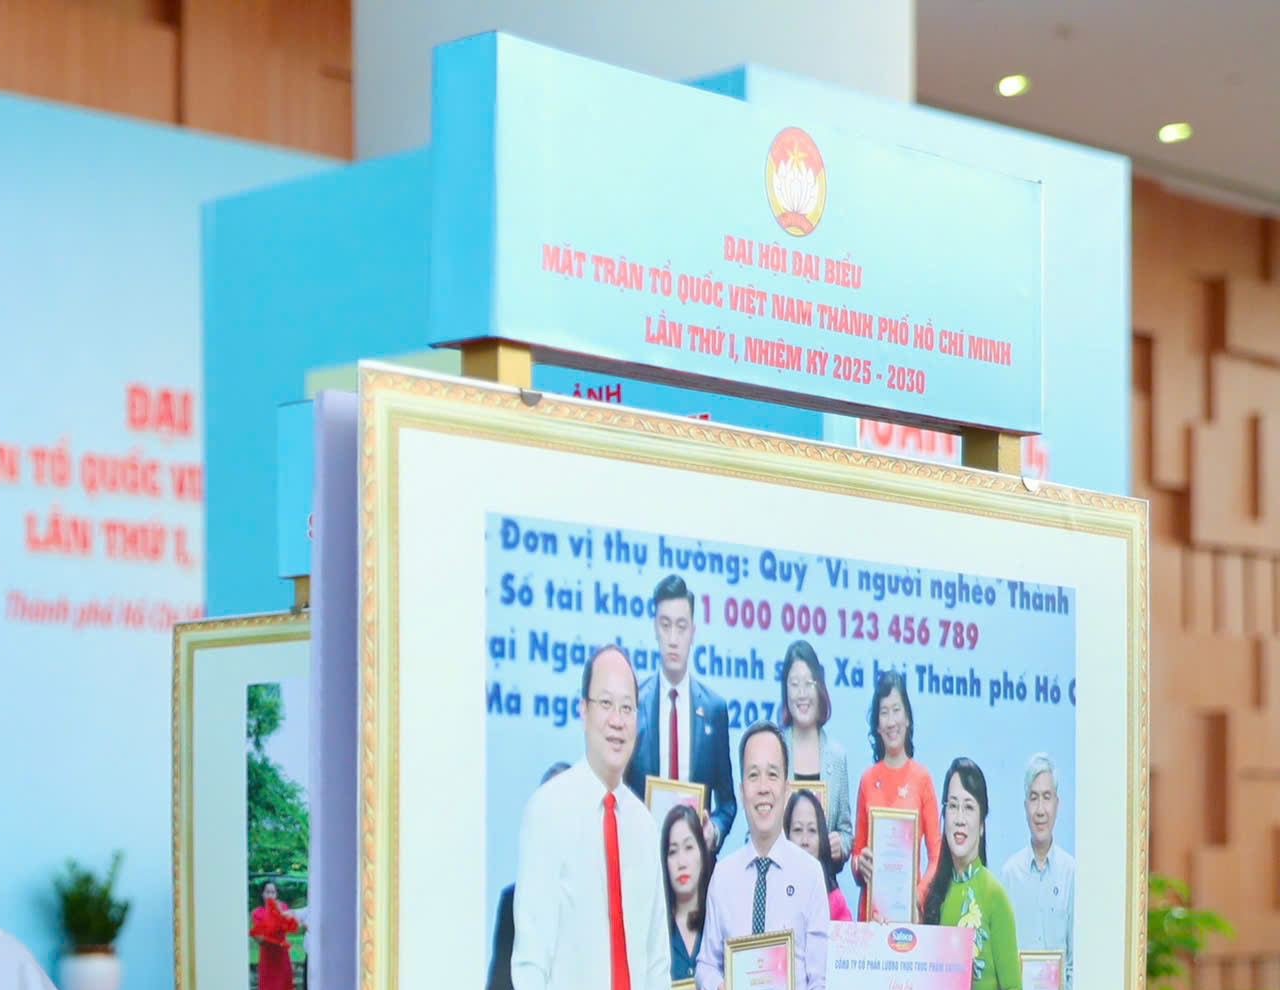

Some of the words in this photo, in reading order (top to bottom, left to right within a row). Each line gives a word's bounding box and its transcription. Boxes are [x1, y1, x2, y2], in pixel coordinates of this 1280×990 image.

[724, 234, 753, 268] ĐẠI
[758, 240, 787, 277] HỘI
[792, 251, 820, 284] ĐẠI
[824, 253, 862, 290] BIỂU
[541, 241, 586, 280] MẶT
[592, 256, 644, 292] TRẬN
[649, 259, 672, 297] TỔ
[678, 271, 723, 308] QUỐC
[728, 284, 767, 320] VIỆT
[772, 294, 813, 327] NAM
[817, 304, 873, 340] THÀNH
[878, 314, 910, 347] PHỐ
[913, 318, 935, 351] HỒ
[938, 329, 964, 358] CHÍ
[968, 335, 1012, 366] MINH
[645, 309, 683, 349] LẦN
[687, 324, 726, 357] THỨ
[728, 333, 739, 364] I,
[744, 335, 802, 374] NHIỆM
[806, 346, 828, 377] KỲ
[833, 354, 872, 385] 2025
[887, 364, 926, 395] 2030
[126, 383, 194, 438] ĐẠI
[80, 448, 162, 496] QUỐC
[25, 506, 92, 556] LẦN
[500, 517, 558, 556] Đơn
[569, 529, 593, 568] vị
[604, 530, 647, 574] thụ
[659, 536, 748, 584] hưởng:
[858, 568, 921, 601] người
[1008, 580, 1069, 615] Thành
[500, 572, 533, 607] Số
[724, 597, 771, 630] 000
[781, 602, 827, 636] 000
[838, 608, 879, 641] 123
[888, 613, 930, 646] 456
[939, 619, 979, 650] 789
[488, 626, 516, 669] ại
[694, 644, 764, 680] Chính
[915, 663, 981, 698] Thành
[990, 670, 1027, 707] phố
